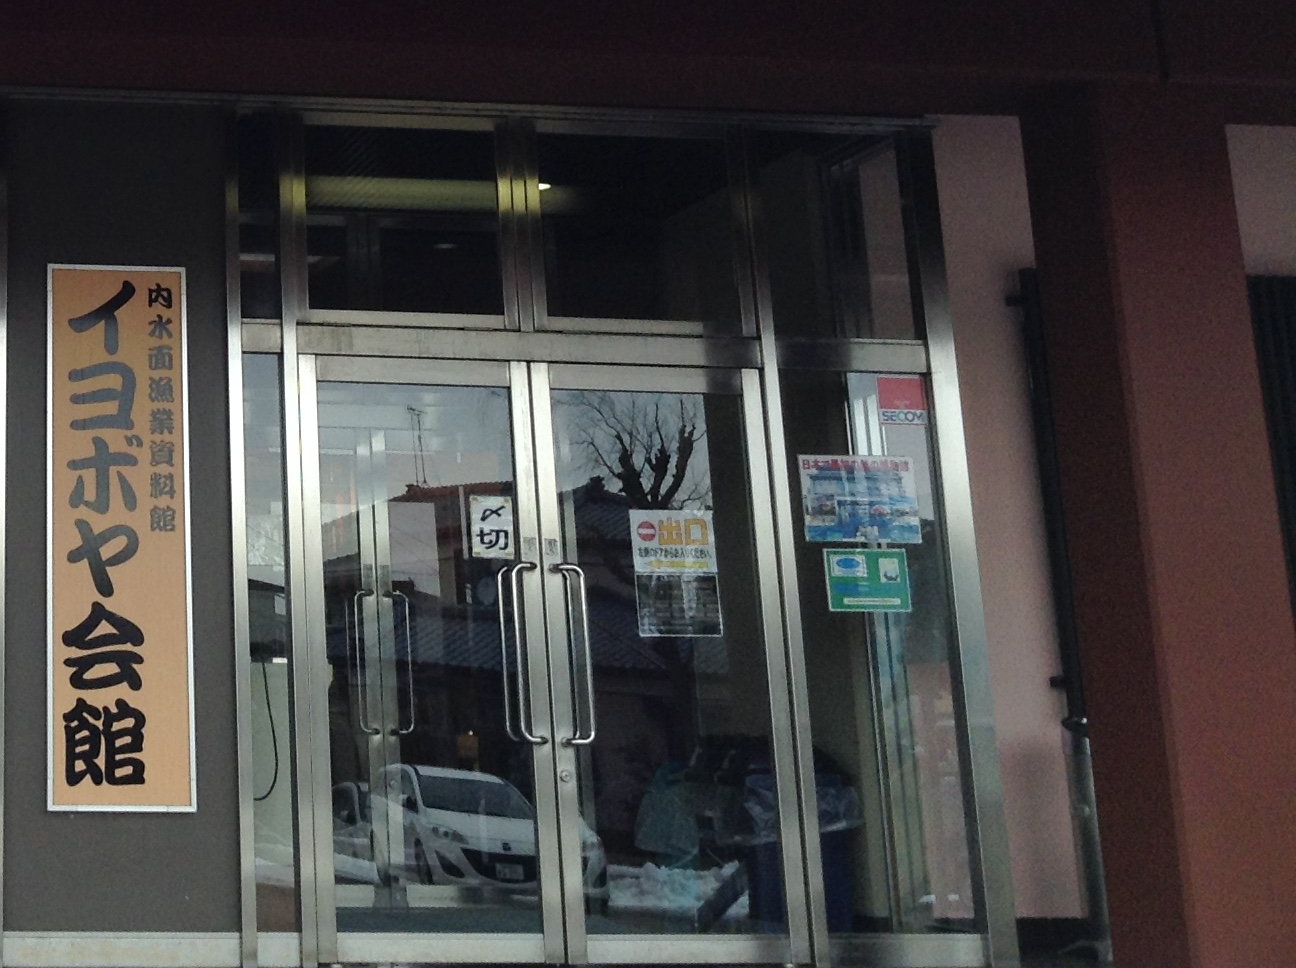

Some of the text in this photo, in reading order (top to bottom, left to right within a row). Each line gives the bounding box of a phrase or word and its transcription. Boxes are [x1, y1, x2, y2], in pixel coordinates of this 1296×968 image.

[146, 282, 177, 533] 内水面漁業資料館
[882, 410, 925, 423] SECOM
[61, 279, 148, 788] イヨボヤ会館
[657, 516, 710, 546] 出口
